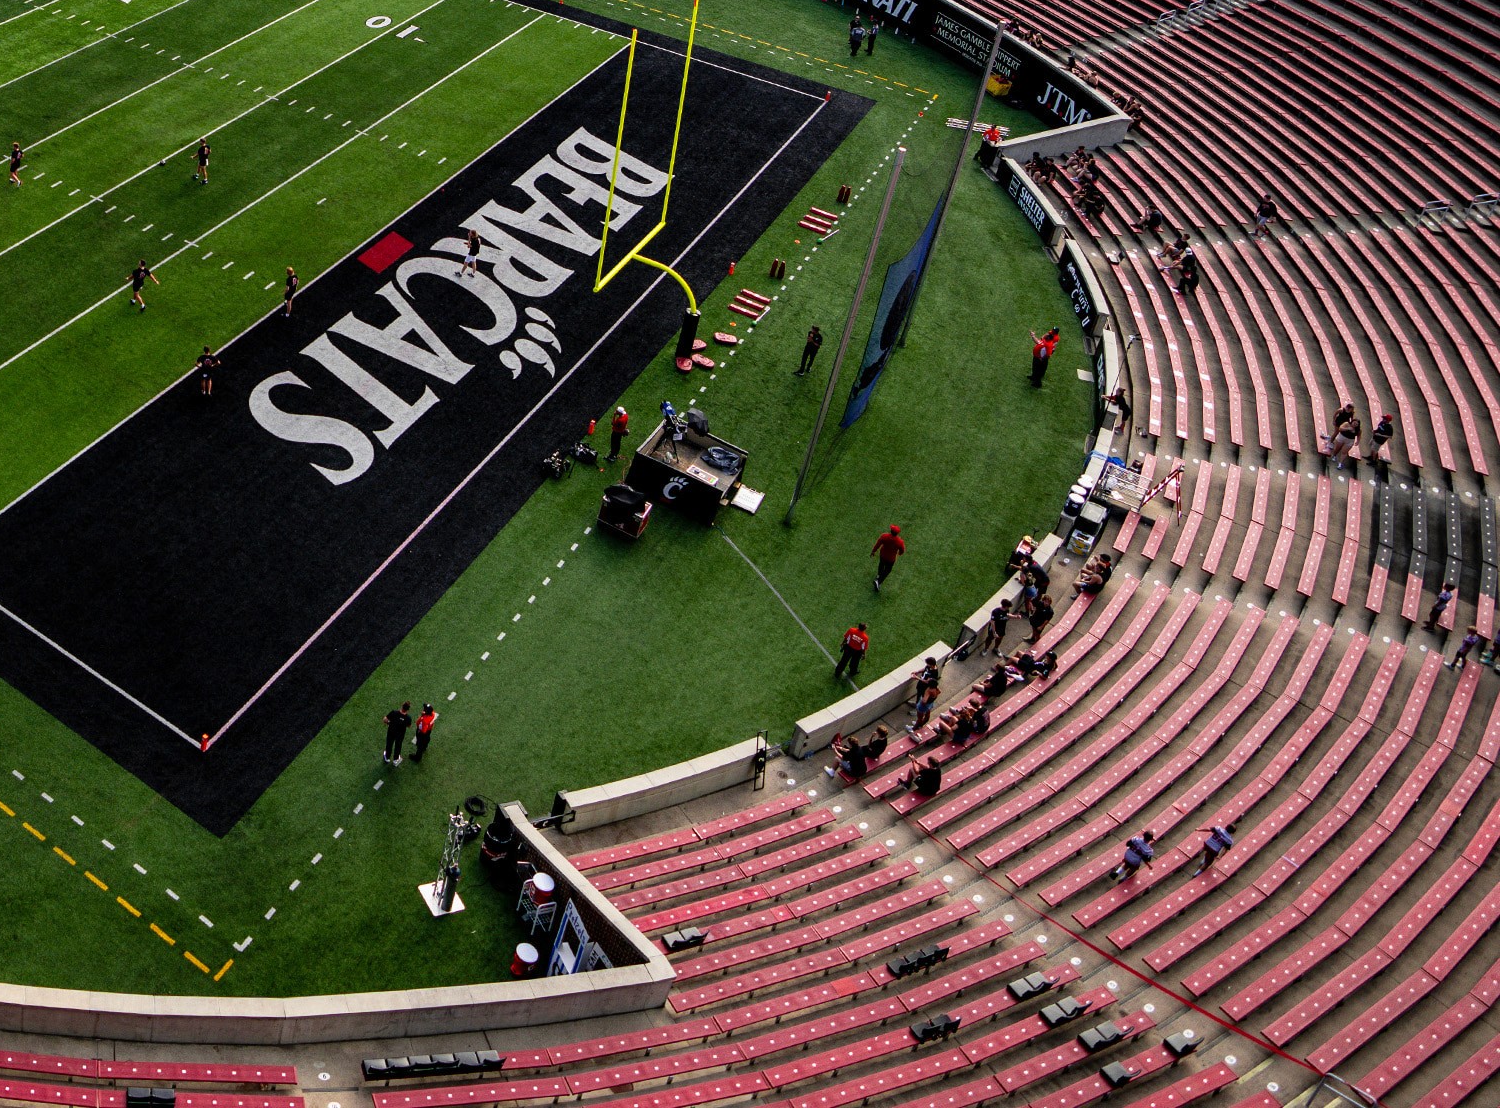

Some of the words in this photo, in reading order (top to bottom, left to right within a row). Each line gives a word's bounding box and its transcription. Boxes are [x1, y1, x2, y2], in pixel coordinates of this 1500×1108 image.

[364, 15, 418, 39] 10
[934, 14, 960, 34] JAMES
[960, 29, 991, 53] GAMBLE
[995, 50, 1021, 71] IPPERT
[936, 27, 977, 56] MEMORIAL
[977, 52, 1012, 77] STDIUM
[1019, 186, 1046, 225] SHELTER
[248, 125, 676, 487] BEARCATS
